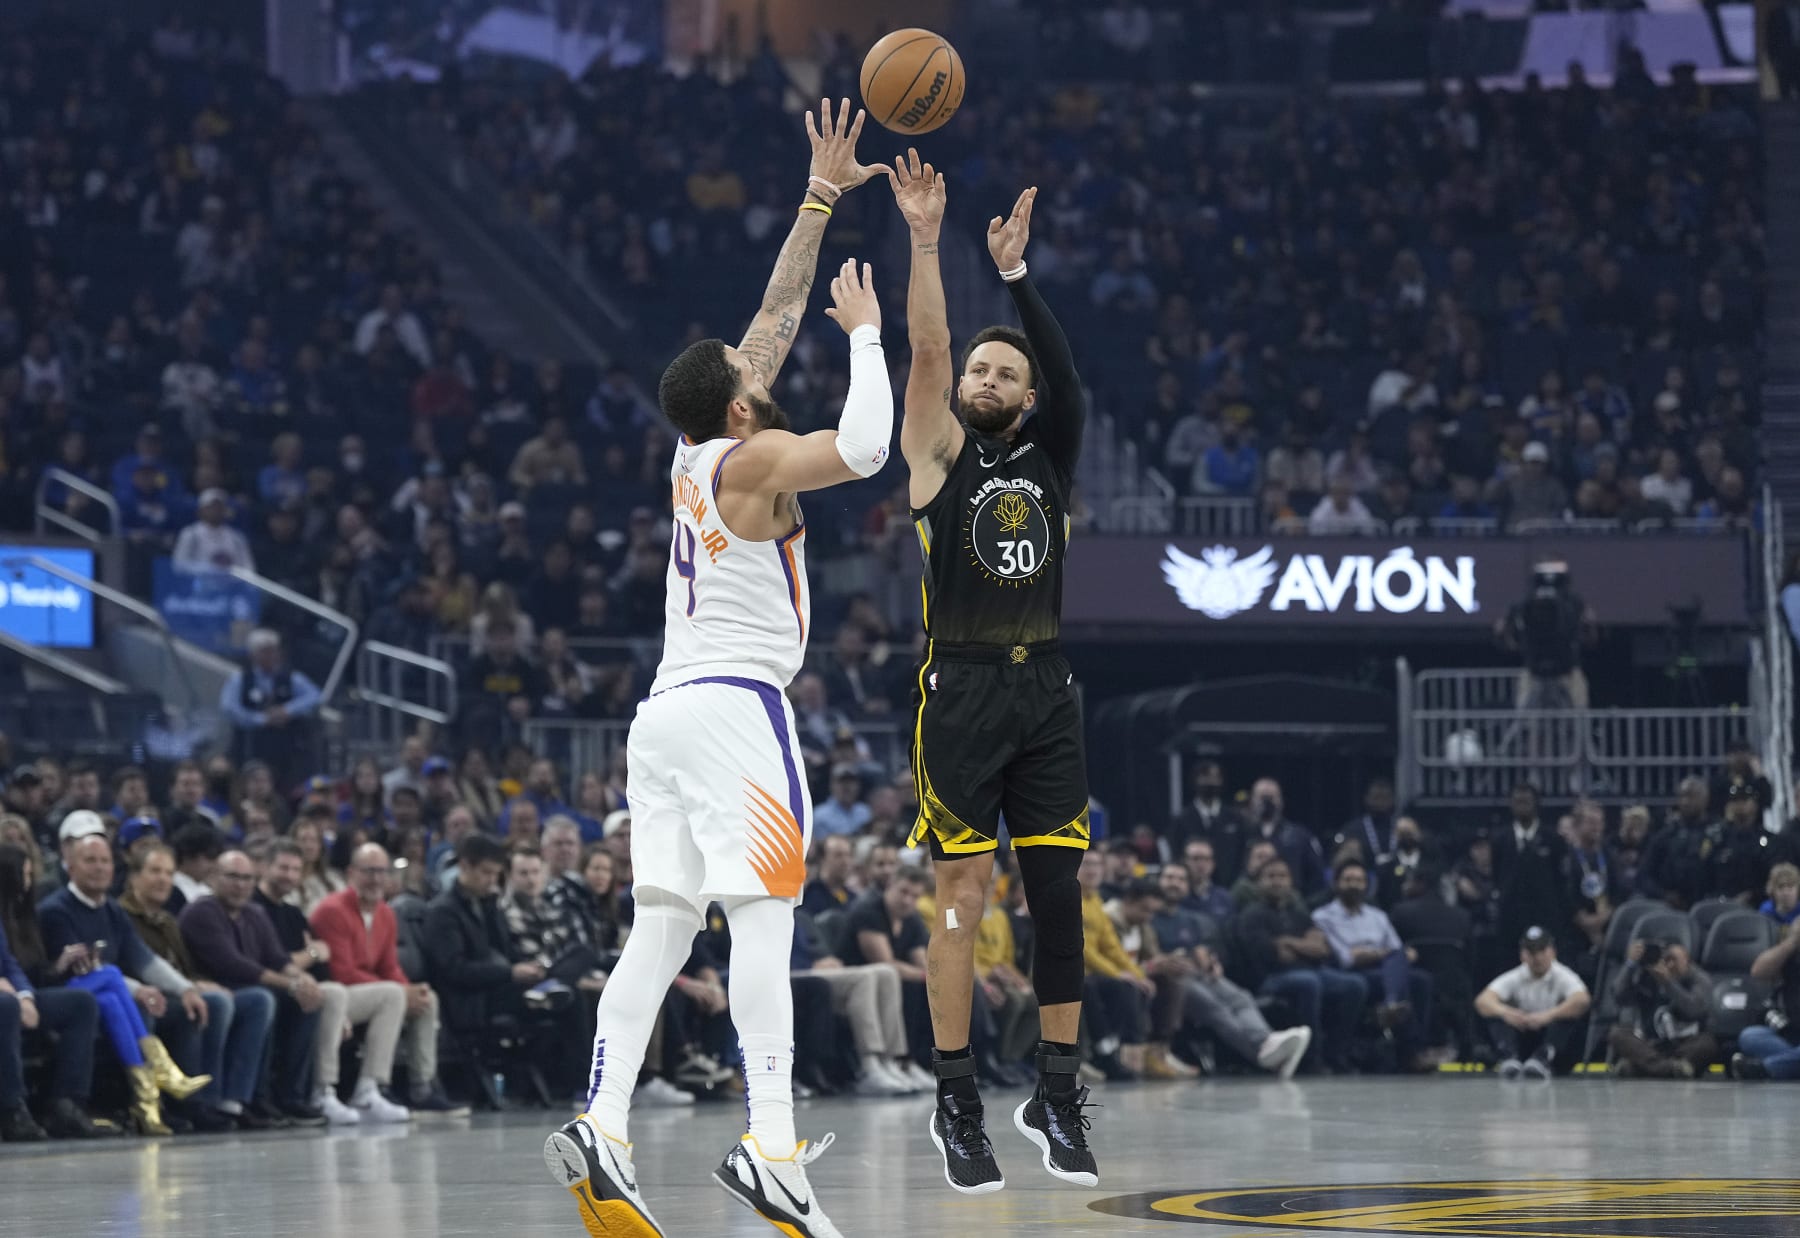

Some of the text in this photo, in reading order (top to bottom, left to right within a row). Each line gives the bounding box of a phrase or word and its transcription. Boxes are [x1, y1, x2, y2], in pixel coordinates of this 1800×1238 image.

[898, 71, 947, 128] Wilson
[969, 477, 1044, 506] WARRIORS
[674, 518, 696, 617] 4
[701, 529, 728, 565] JR.
[996, 539, 1036, 575] 30
[1269, 546, 1478, 613] AVIÓN
